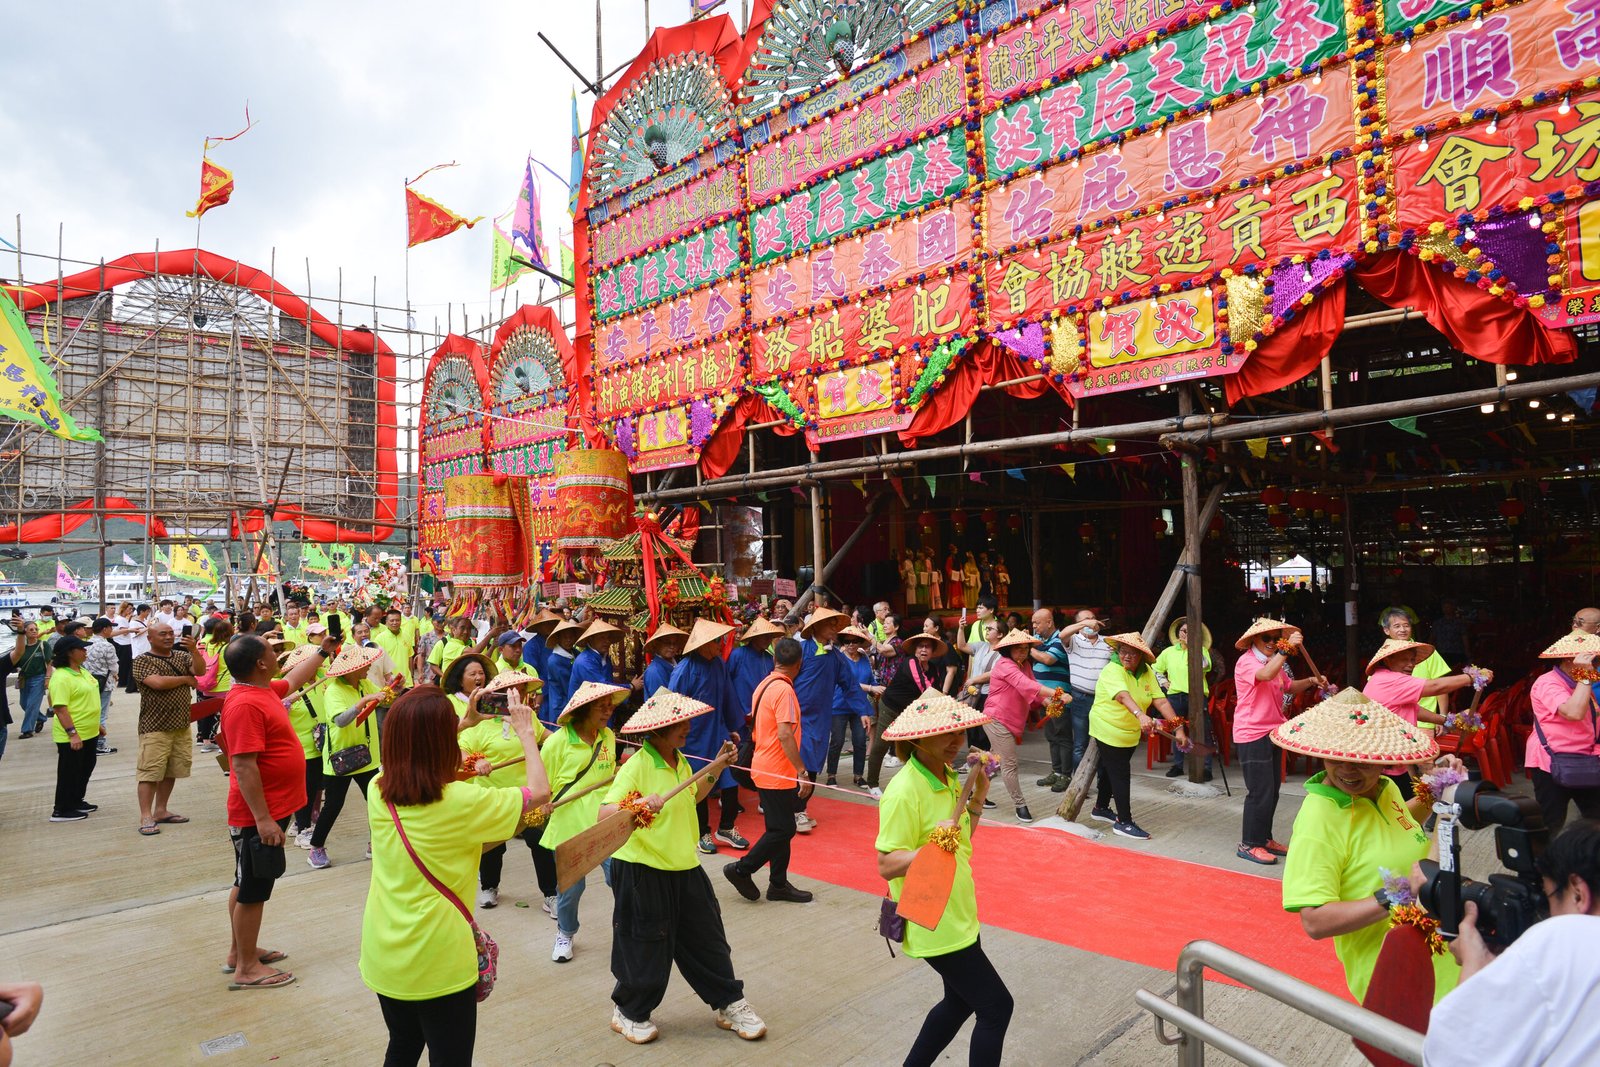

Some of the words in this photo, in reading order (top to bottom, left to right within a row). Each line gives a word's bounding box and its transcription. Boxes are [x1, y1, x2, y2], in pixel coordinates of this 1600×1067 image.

[764, 210, 957, 315] 國泰民安
[997, 174, 1349, 316] 西貢遊艇協會
[604, 288, 733, 362] 合境平安
[763, 284, 961, 374] 肥婆船務
[1101, 299, 1206, 359] 敬賀
[823, 369, 887, 413] 敬賀
[643, 412, 683, 447] 敬賀
